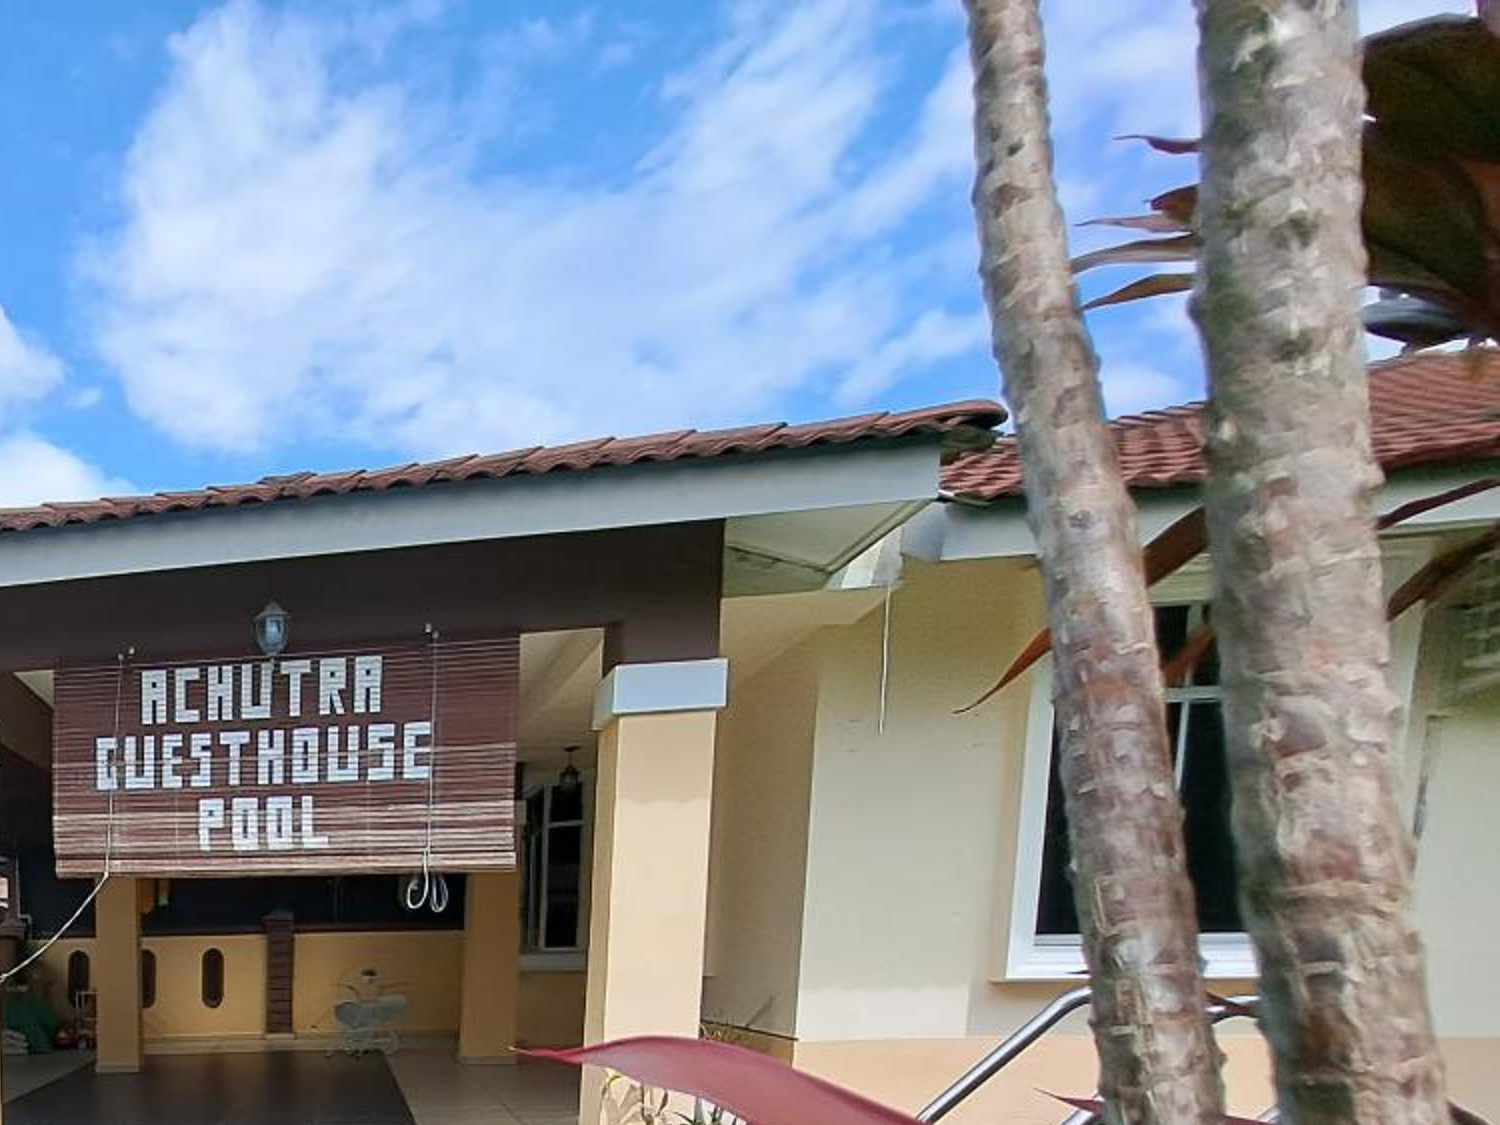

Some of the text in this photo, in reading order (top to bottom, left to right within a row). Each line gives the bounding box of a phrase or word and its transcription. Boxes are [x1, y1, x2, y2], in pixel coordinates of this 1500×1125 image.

[141, 656, 383, 724] ACHUTRA
[95, 721, 431, 791] GUESTHOUSE
[199, 795, 330, 851] POOL
